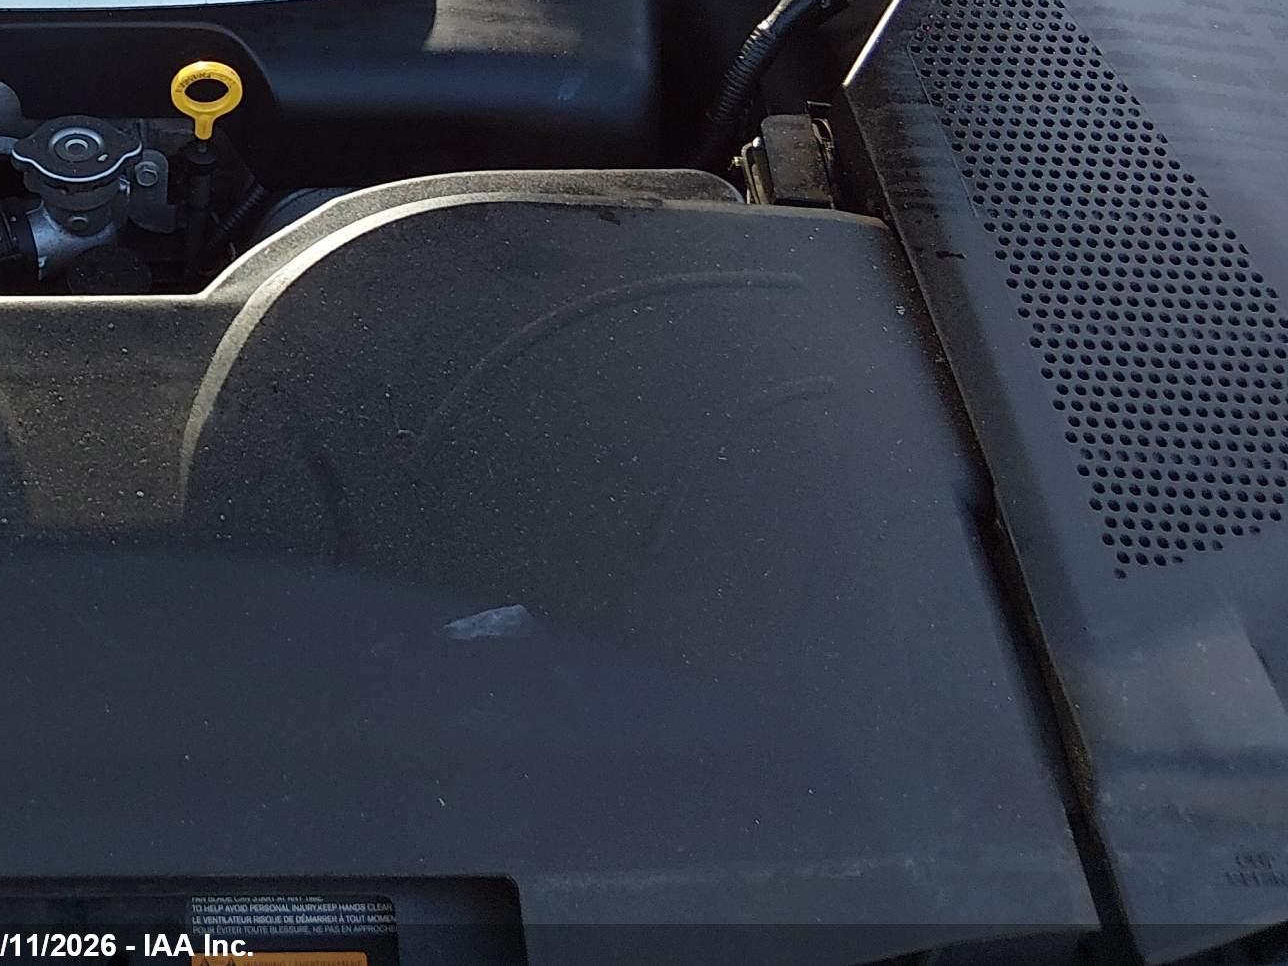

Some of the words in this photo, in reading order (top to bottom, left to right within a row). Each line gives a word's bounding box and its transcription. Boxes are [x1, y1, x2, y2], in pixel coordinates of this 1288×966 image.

[192, 904, 202, 912] TO
[204, 904, 223, 912] HELP
[225, 904, 247, 912] AVOID
[249, 904, 289, 912] PERSONAL
[339, 904, 365, 912] HANDS
[192, 915, 201, 924] LE
[203, 915, 252, 924] VENTILATEUR
[254, 915, 281, 924] RISQUE
[283, 915, 294, 924] DE
[346, 915, 365, 924] TOUT
